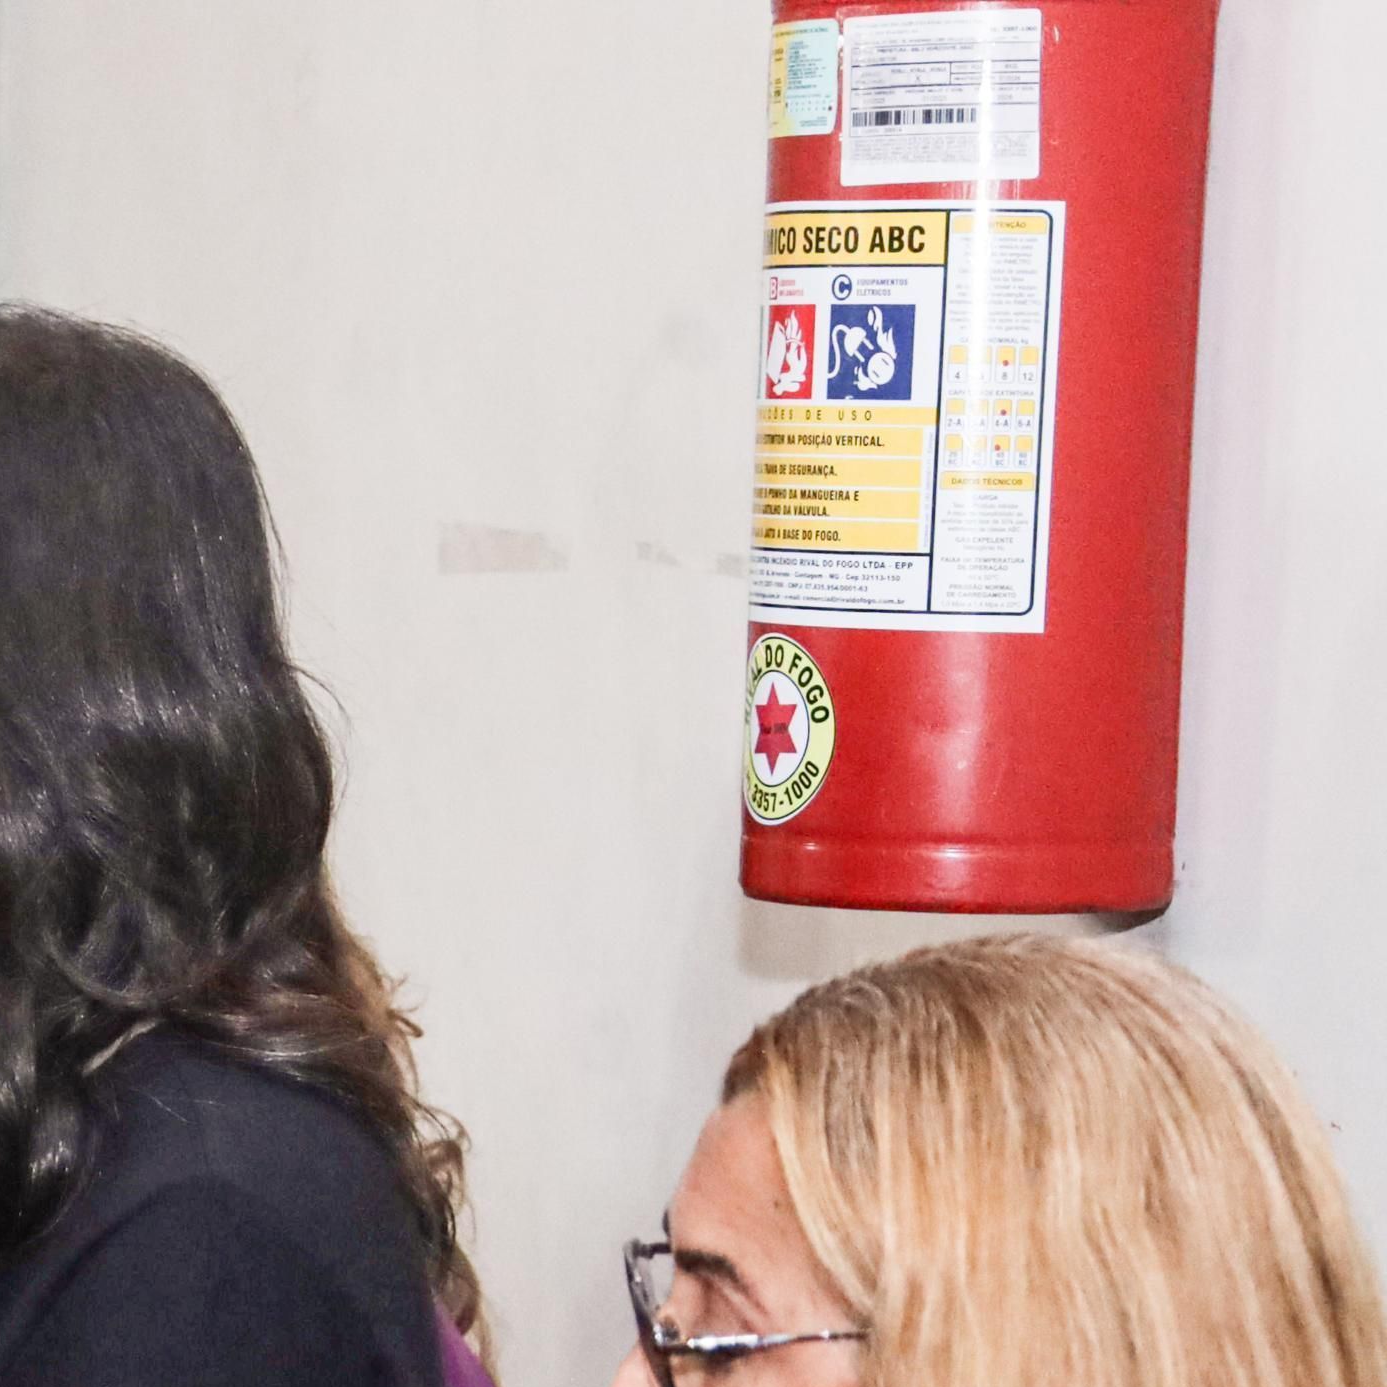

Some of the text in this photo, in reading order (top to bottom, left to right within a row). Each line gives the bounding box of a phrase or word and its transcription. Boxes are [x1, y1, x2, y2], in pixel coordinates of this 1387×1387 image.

[803, 226, 859, 254] SECO
[869, 225, 926, 254] ABC
[832, 275, 852, 299] C
[1023, 373, 1034, 381] 12
[805, 409, 822, 421] DE
[838, 410, 873, 421] USO
[787, 434, 795, 445] NA
[798, 432, 833, 448] POSIÇÃO
[835, 435, 885, 447] VERTICAL.
[779, 464, 787, 475] DE
[789, 464, 838, 479] SEGURANÇA.
[789, 489, 798, 499] DA
[800, 490, 851, 501] MANGUEIRA
[854, 490, 860, 501] E
[783, 505, 792, 516] DA
[783, 529, 799, 540] BASE
[802, 530, 812, 541] DO
[815, 530, 841, 542] FOGO.
[799, 558, 820, 567] RIVAL
[822, 559, 834, 568] DO
[836, 560, 860, 569] FOGO
[862, 560, 886, 569] LTDA
[895, 562, 914, 570] EPP
[765, 644, 784, 668] DO
[789, 652, 830, 723] FOGO
[752, 761, 820, 812] 3357-1000
